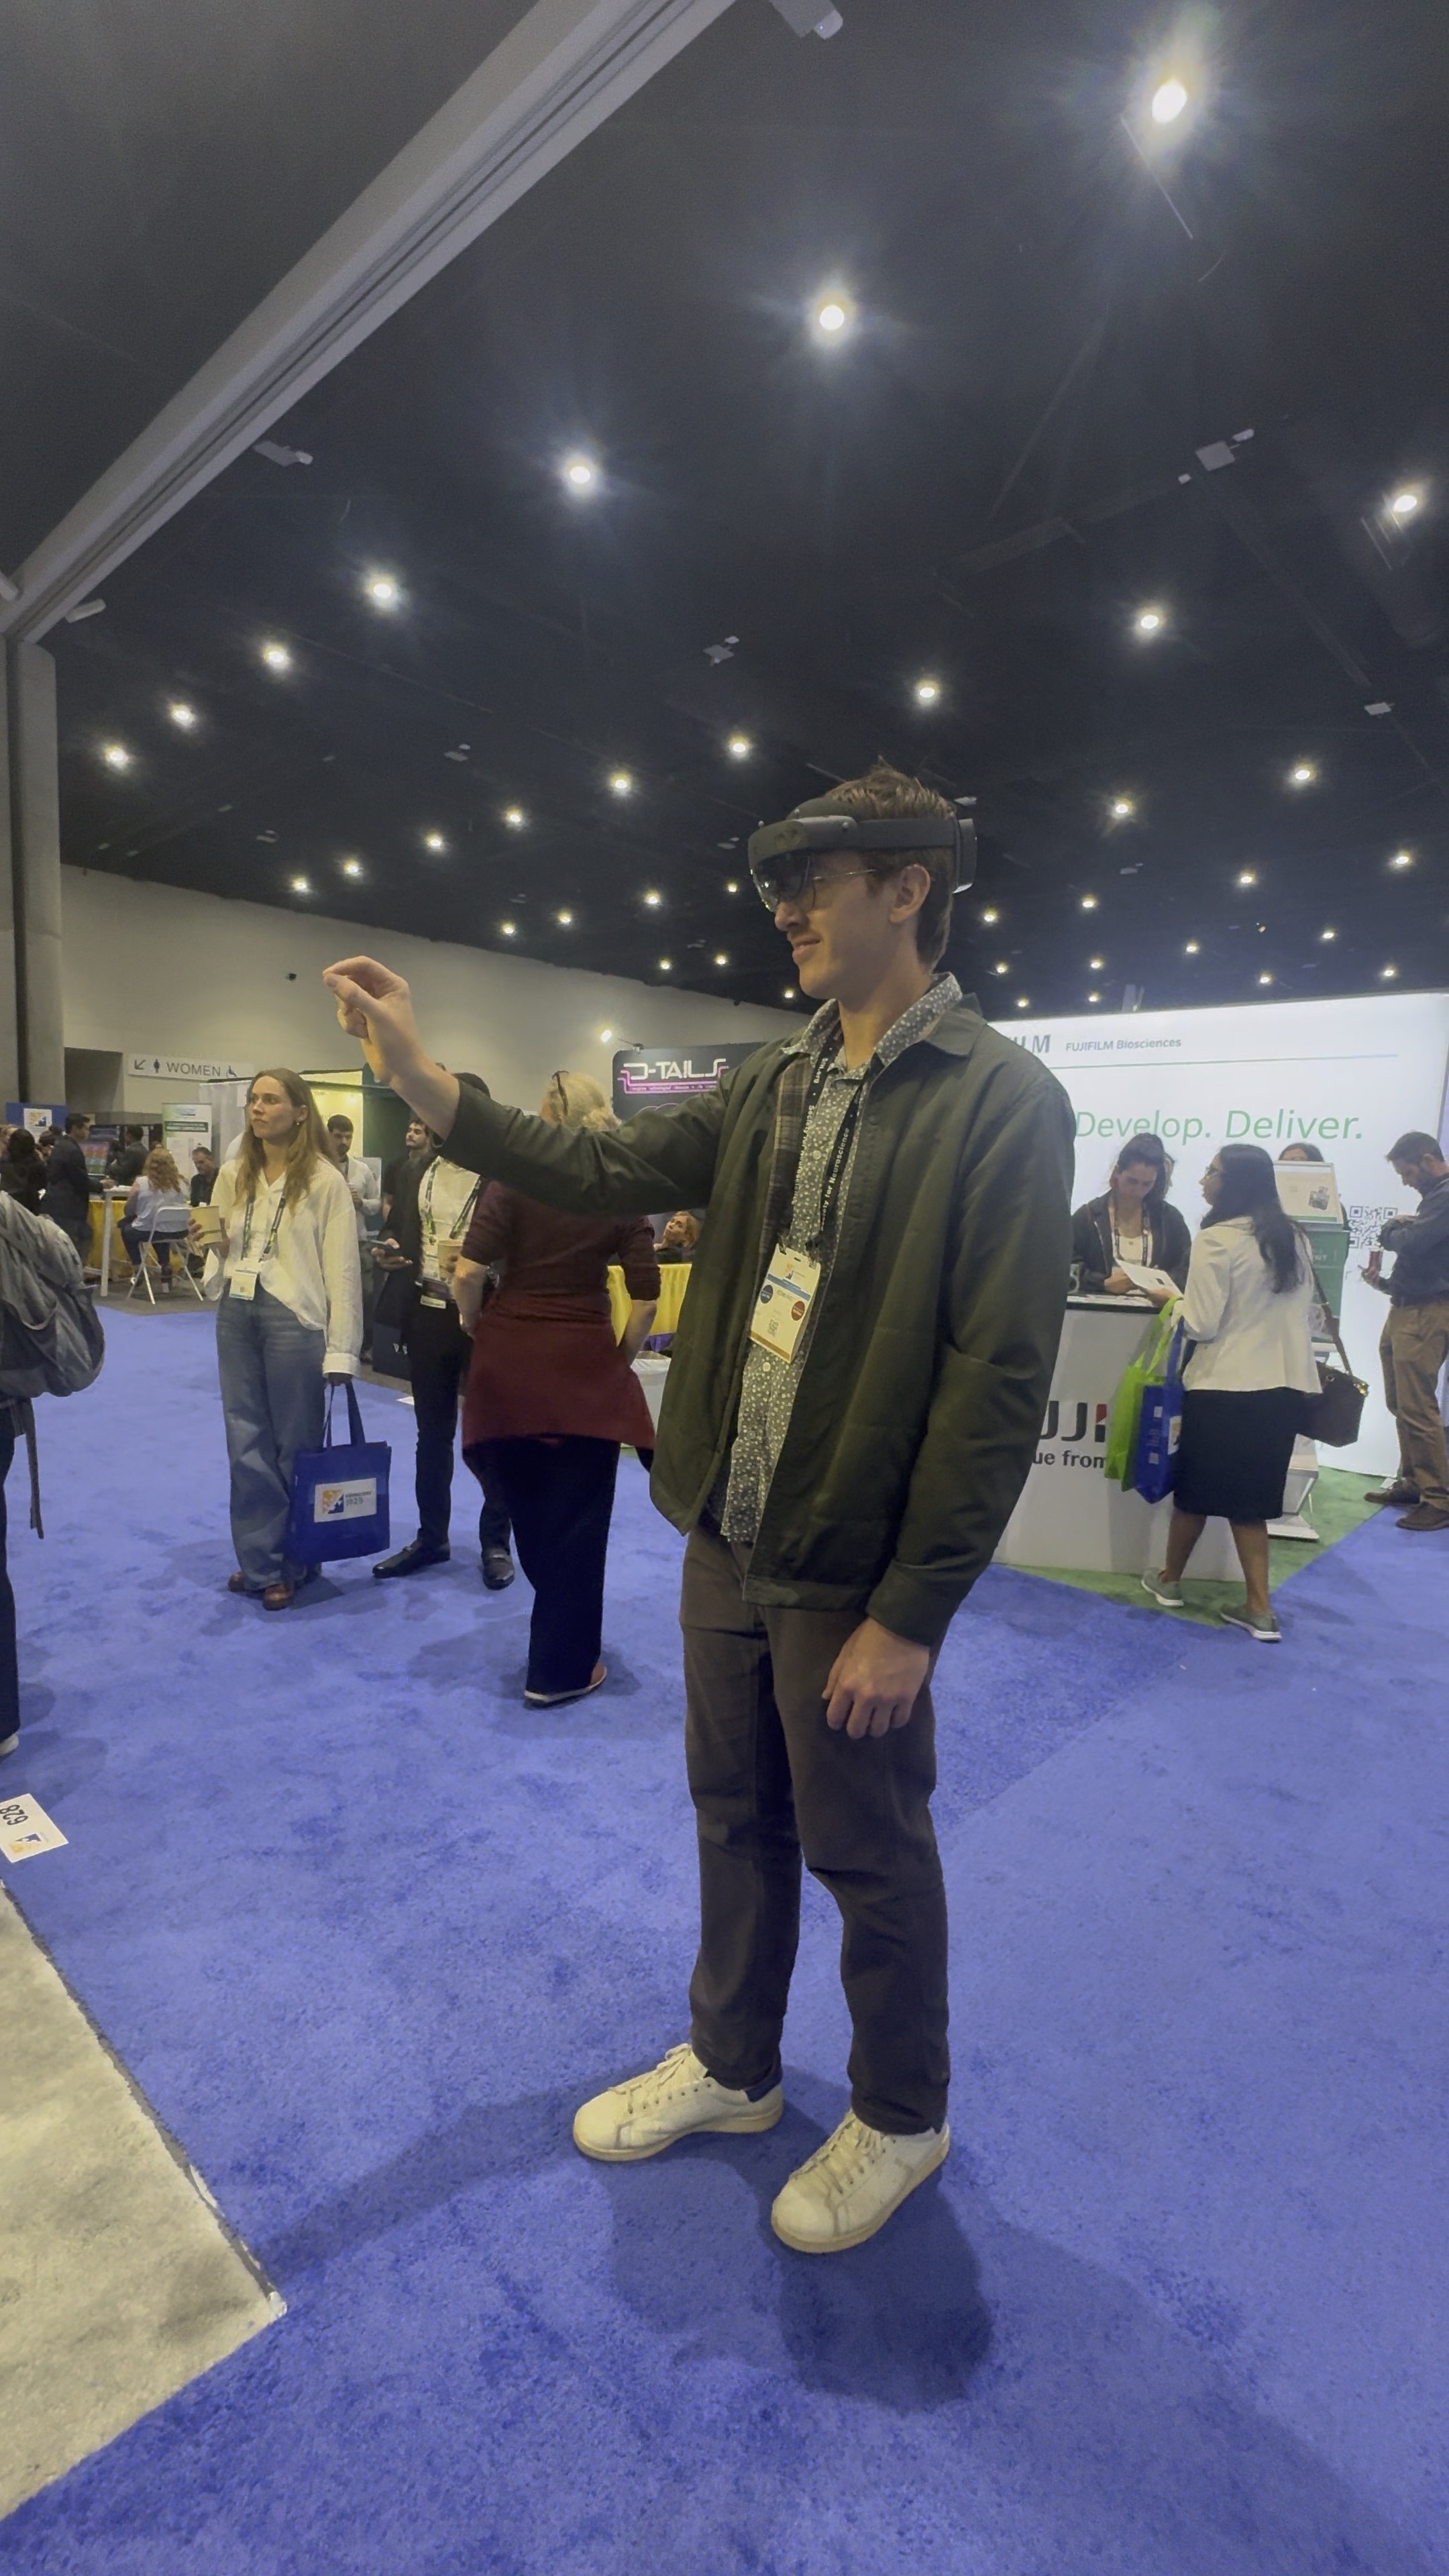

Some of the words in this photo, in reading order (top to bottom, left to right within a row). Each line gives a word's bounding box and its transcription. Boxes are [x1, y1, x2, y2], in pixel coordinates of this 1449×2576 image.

[1066, 1040, 1114, 1052] FUJIFILM
[1116, 1038, 1182, 1050] Biosciences
[166, 1062, 221, 1077] WOMEN
[1076, 1110, 1211, 1145] Develop.
[1226, 1108, 1362, 1139] Deliver.
[0, 1804, 29, 1825] 628
